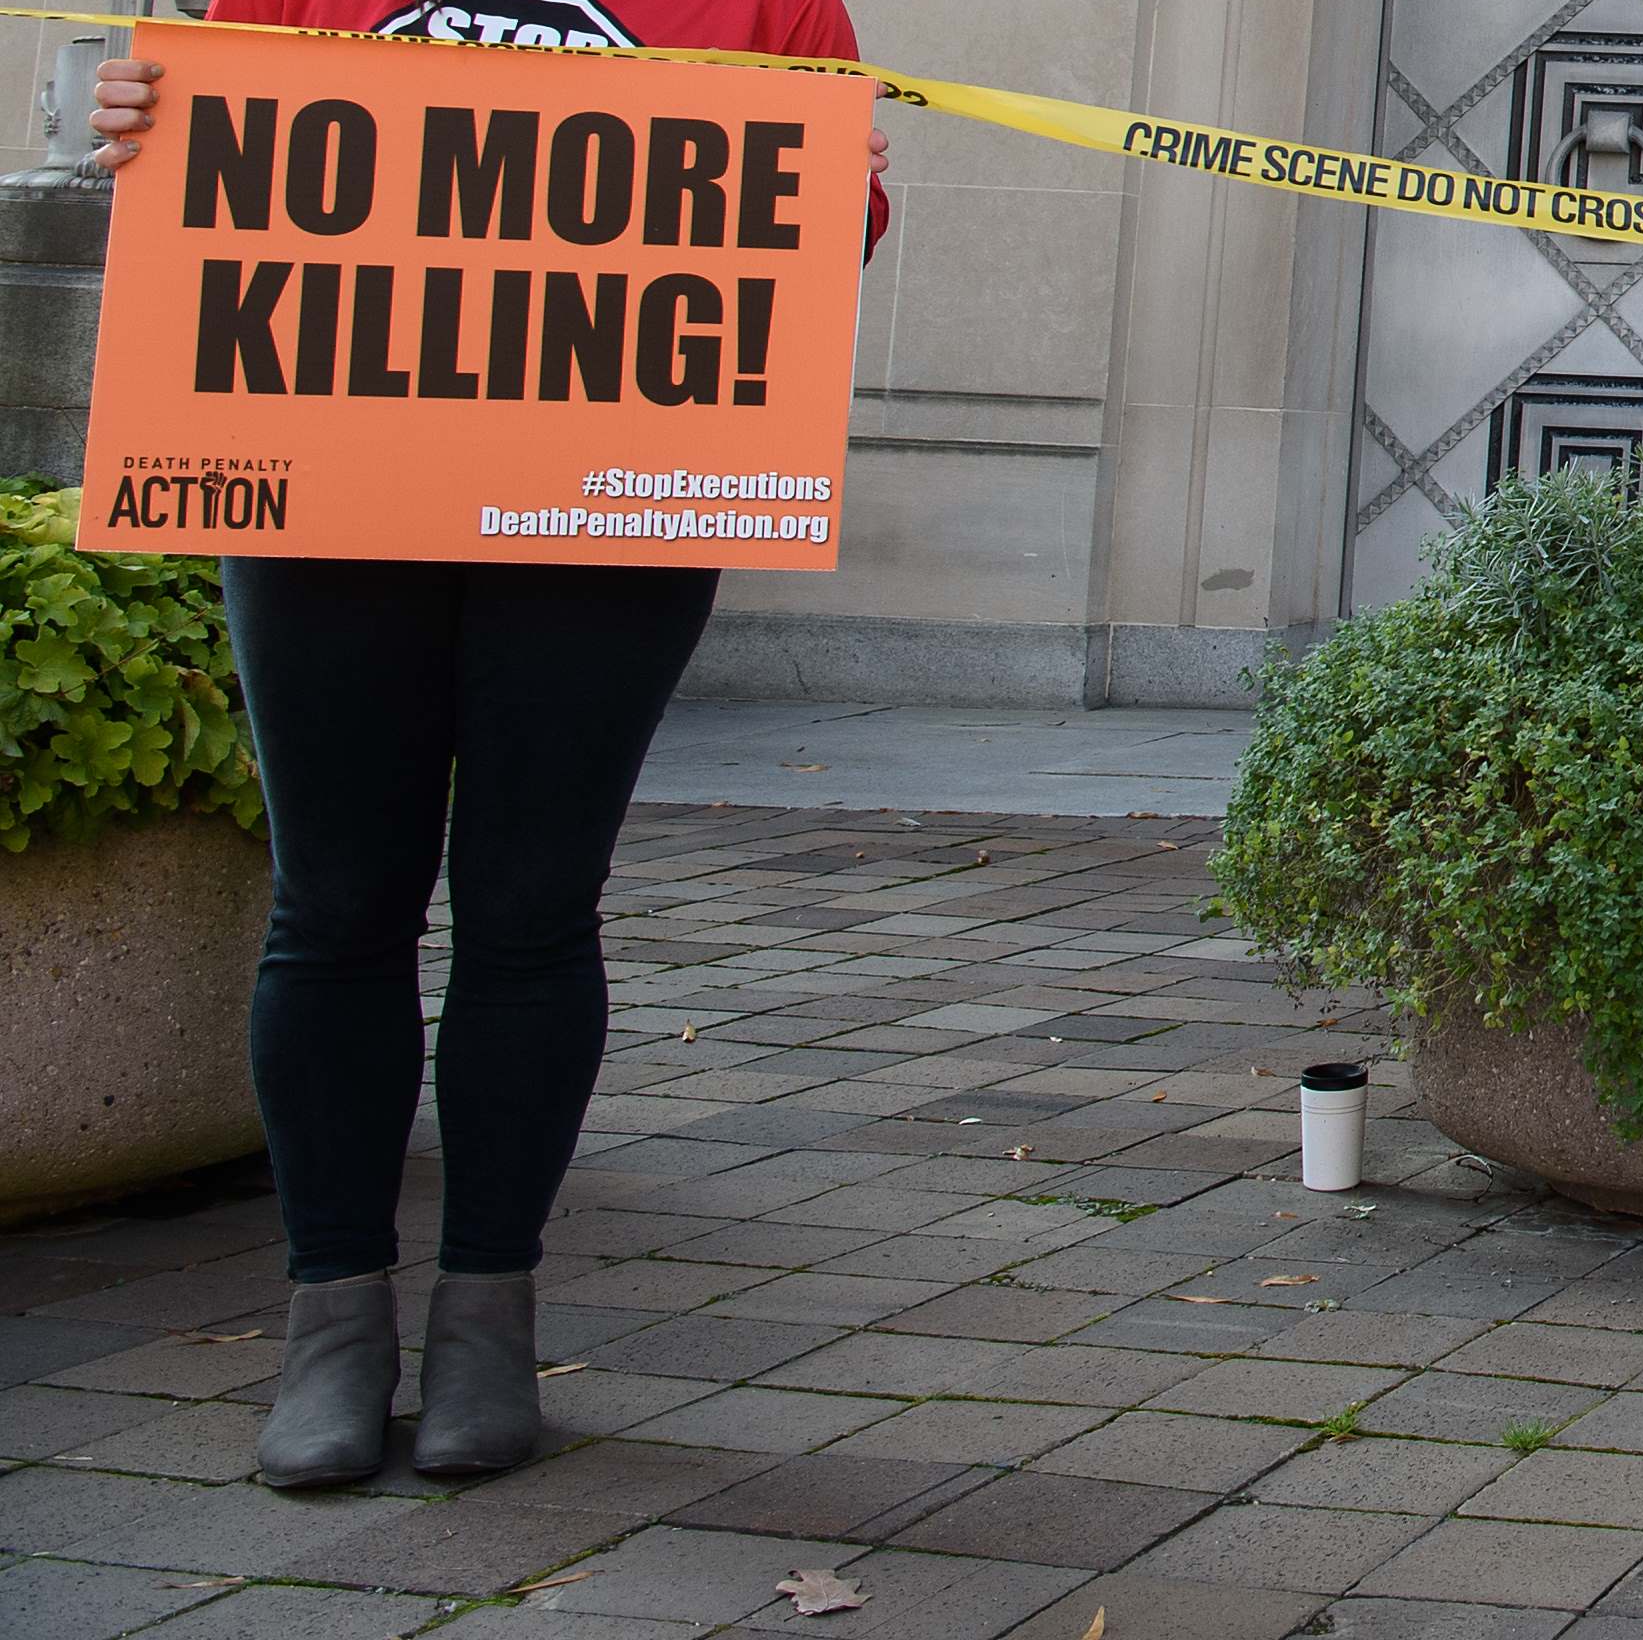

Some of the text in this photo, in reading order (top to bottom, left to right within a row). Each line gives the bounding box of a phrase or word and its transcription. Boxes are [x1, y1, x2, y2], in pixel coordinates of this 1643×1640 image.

[182, 94, 805, 250] NO MORE
[1122, 121, 1257, 177] CRIME
[1260, 145, 1390, 198] SCENE
[1400, 167, 1455, 206] DO
[1463, 179, 1546, 219] NOT
[193, 259, 777, 407] KILLING!
[123, 455, 293, 472] DEATH PENALTY
[582, 468, 832, 502] #StopExecutions
[108, 470, 288, 530] ACTION
[480, 507, 831, 543] DeathPenaltyAction.org
